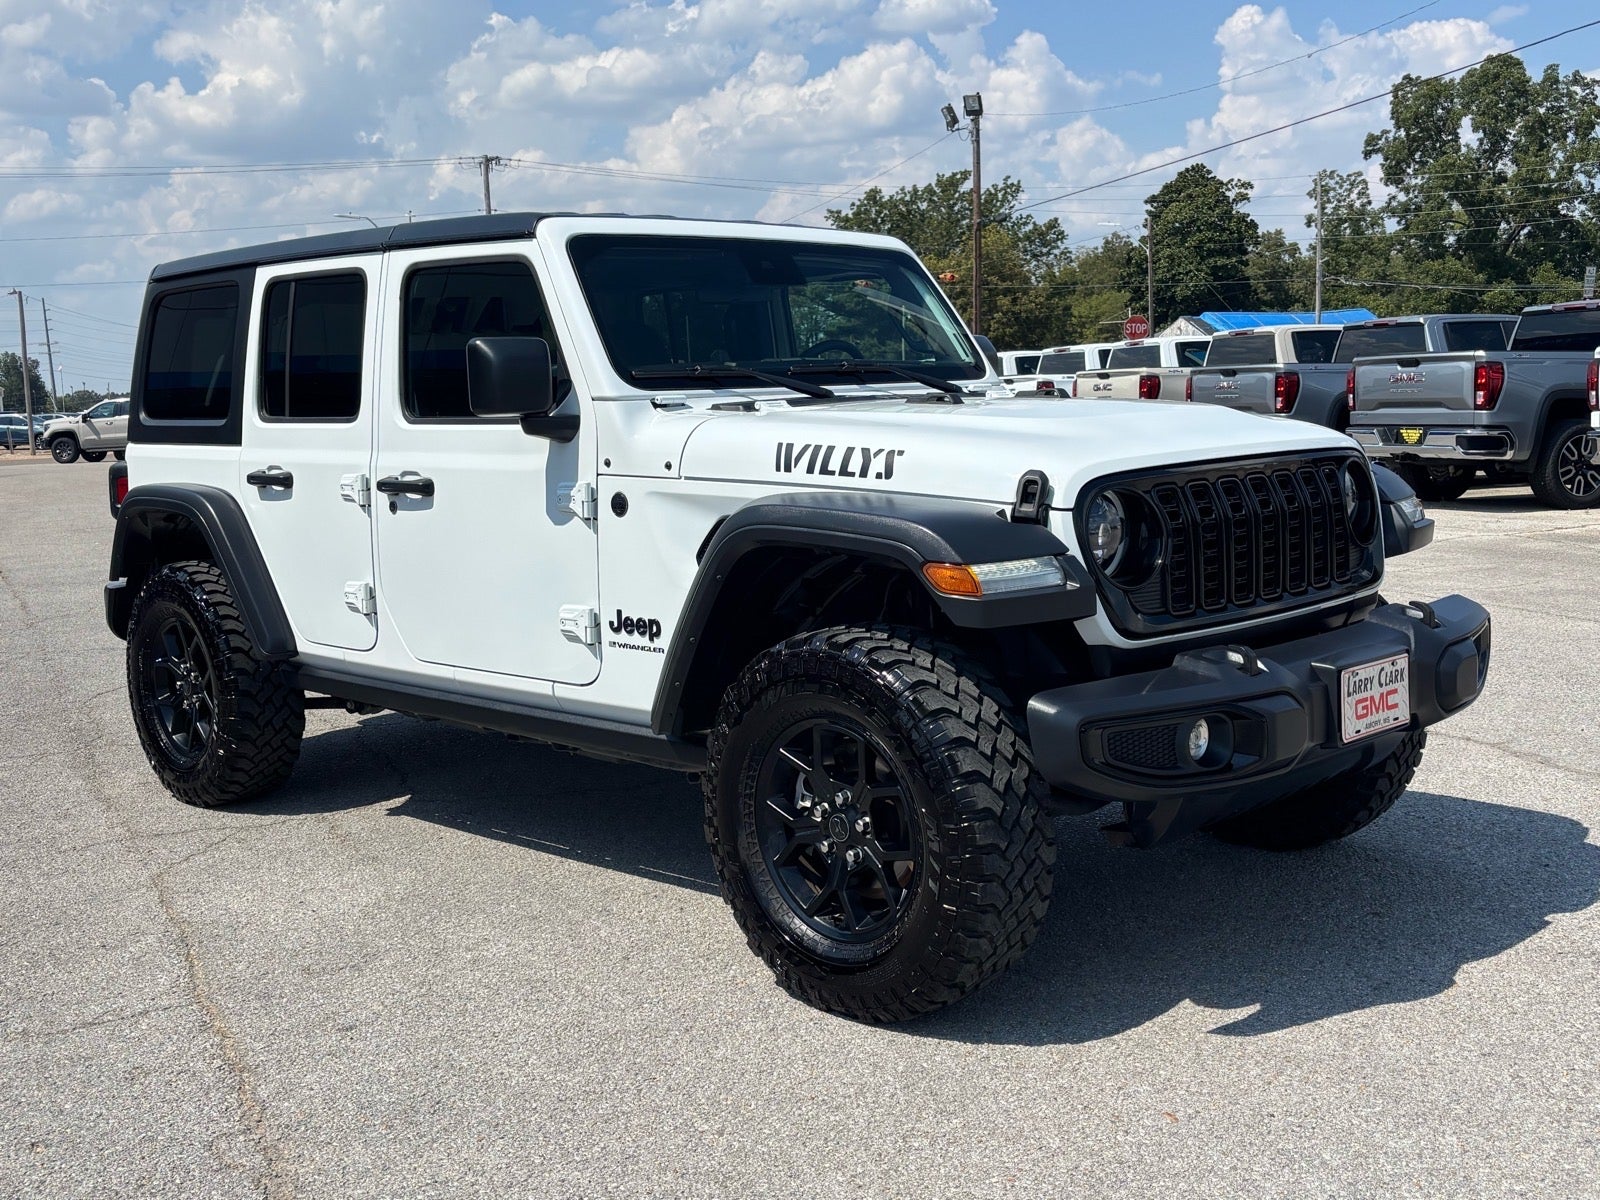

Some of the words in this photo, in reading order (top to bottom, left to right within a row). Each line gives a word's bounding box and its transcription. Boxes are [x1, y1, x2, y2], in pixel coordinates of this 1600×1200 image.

[1126, 323, 1147, 334] STOP
[775, 442, 905, 480] WILLYS
[608, 608, 662, 643] Jeep
[617, 641, 665, 654] WRANGLER
[1347, 675, 1374, 697] LARRY
[1378, 667, 1405, 688] CLARK
[1355, 688, 1399, 720] GMC
